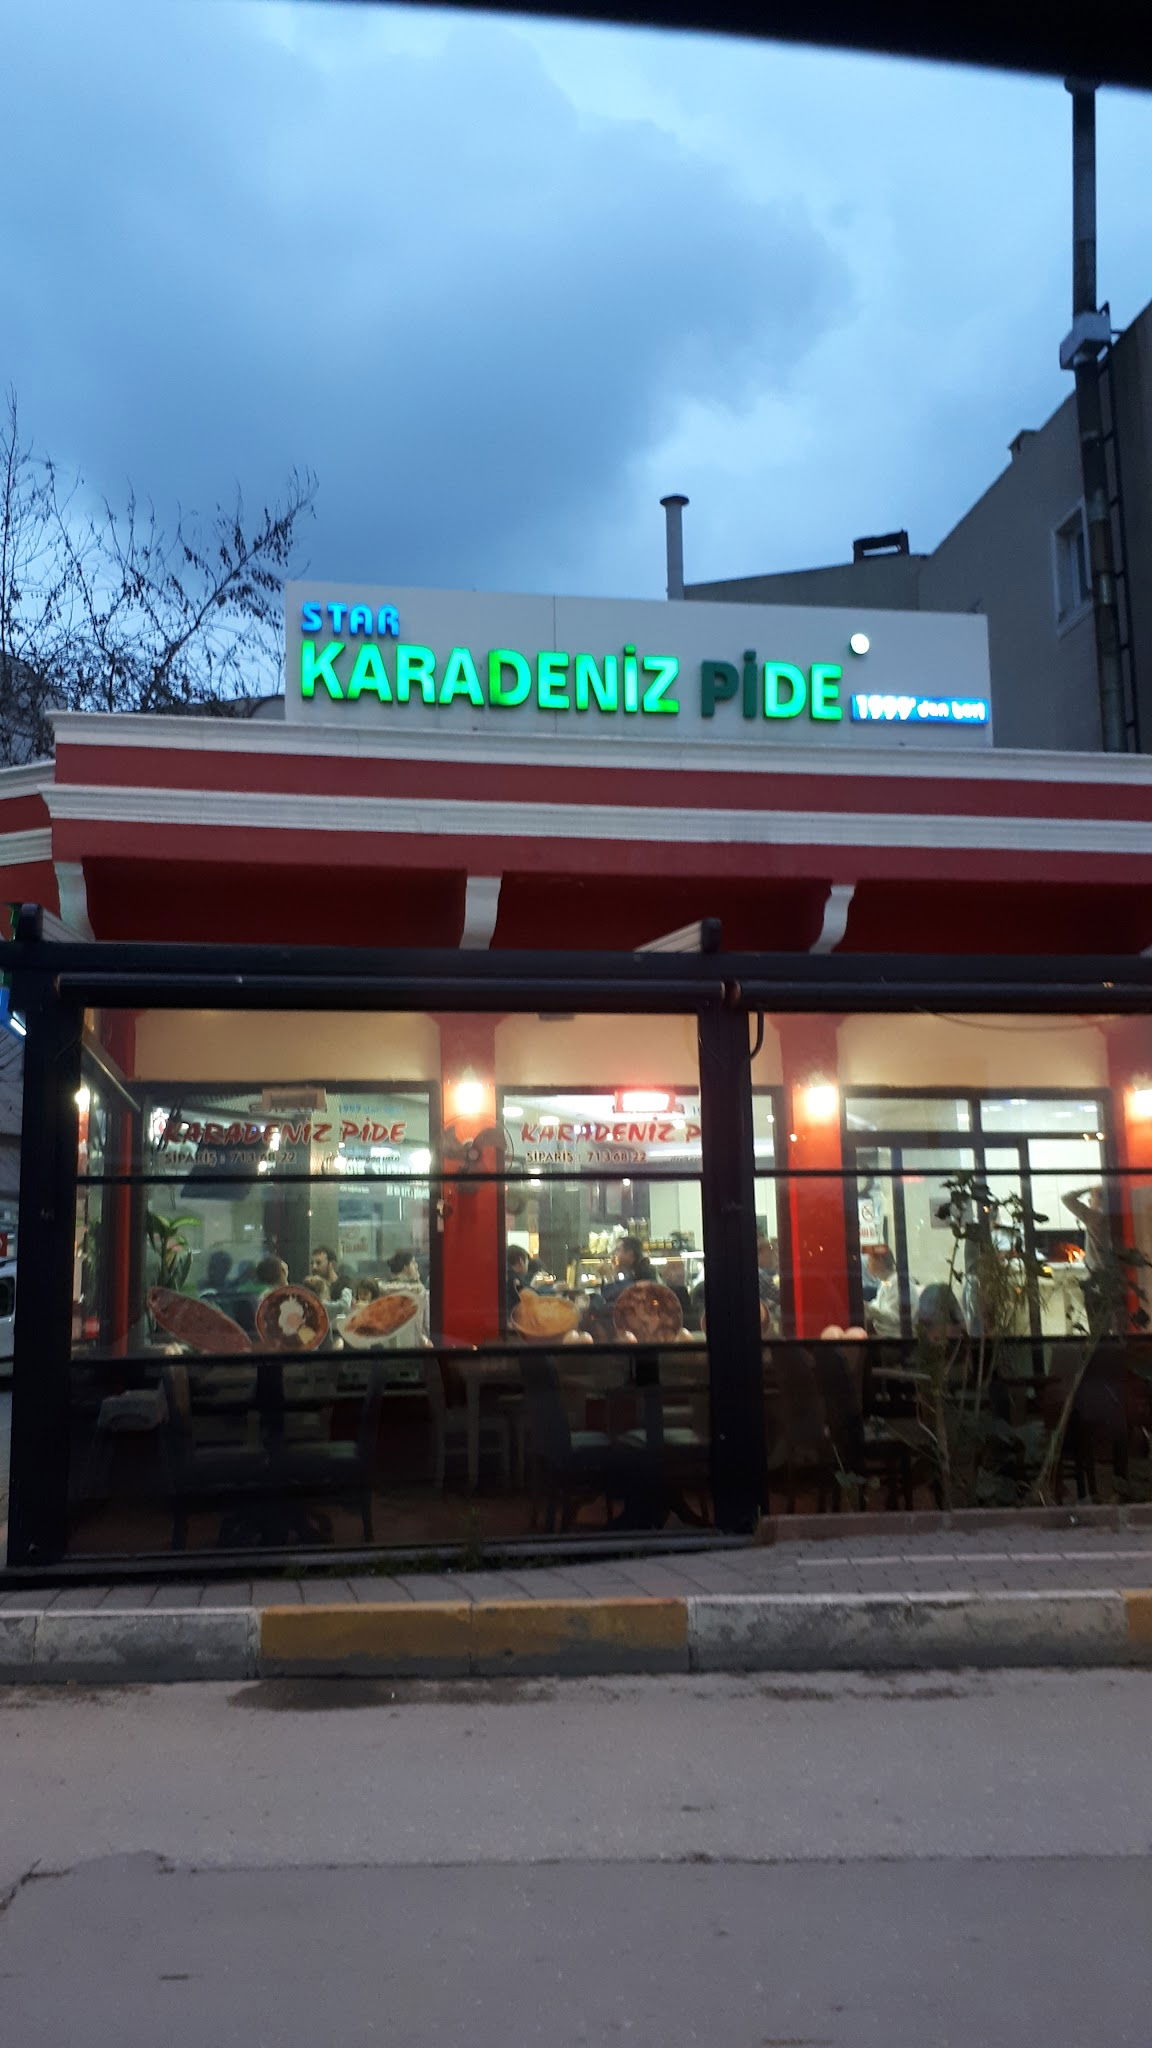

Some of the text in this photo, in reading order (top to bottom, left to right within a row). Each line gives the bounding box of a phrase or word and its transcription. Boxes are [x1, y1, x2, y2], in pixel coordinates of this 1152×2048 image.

[301, 601, 400, 636] STAR
[302, 639, 843, 721] KARADENİZ PİDE
[163, 1116, 407, 1144] KARADENİZ PİDE
[520, 1116, 676, 1143] KARADENİZ
